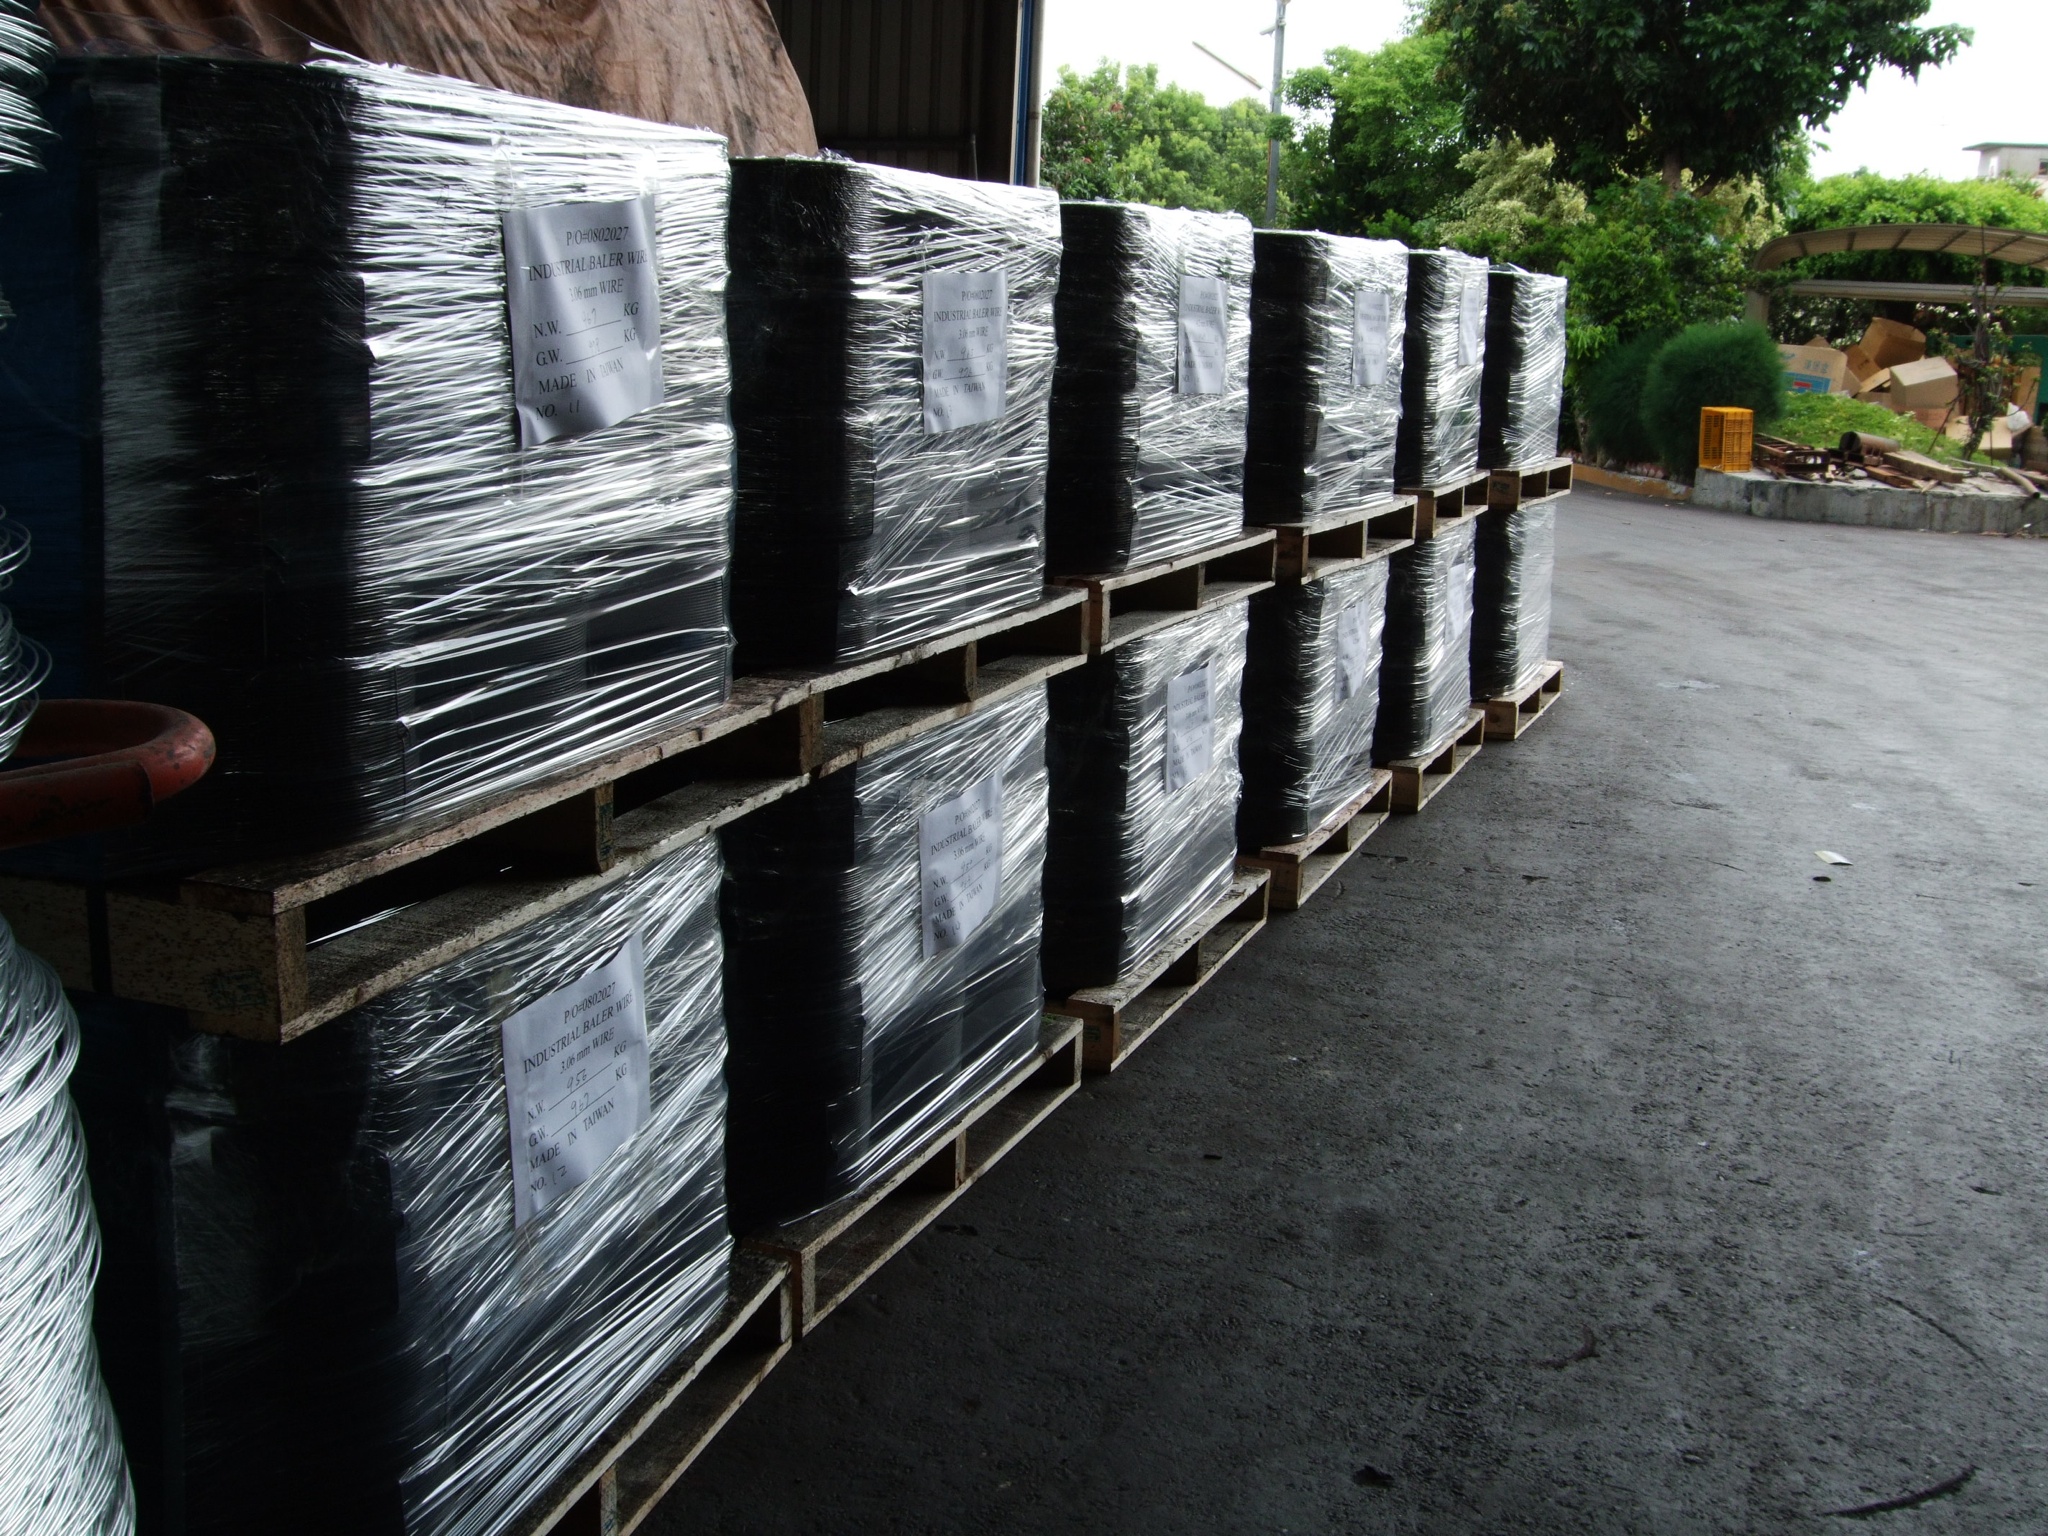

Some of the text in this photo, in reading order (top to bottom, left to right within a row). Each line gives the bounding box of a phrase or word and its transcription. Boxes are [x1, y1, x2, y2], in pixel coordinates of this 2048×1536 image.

[529, 258, 586, 281] INDUSTRIAL
[590, 252, 623, 270] BALER
[584, 287, 598, 297] mm
[599, 278, 623, 294] WIRE
[534, 320, 562, 338] N.W.
[623, 302, 639, 316] KG
[934, 309, 971, 322] INDUSTRIAL
[972, 308, 989, 319] BALER
[976, 327, 988, 337] WIRE
[536, 348, 562, 366] G.W.
[624, 328, 636, 342] KG
[987, 343, 994, 353] KG
[539, 358, 623, 394] MADE IN TAIWAN
[934, 382, 986, 398] MADE IN TAIWAN
[536, 404, 557, 420] NO.
[931, 831, 968, 855] INDUSTRIAL
[933, 906, 956, 924] MADE
[524, 990, 633, 1074] INDUSTRIAL BALER WIRE
[560, 1027, 615, 1074] 3.06 mm WIRE
[527, 1100, 546, 1123] N.W.
[614, 1040, 627, 1058] KG
[615, 1062, 627, 1081] KG
[530, 1098, 615, 1172] MADE IN TAIWAN
[530, 1177, 547, 1196] NO.
